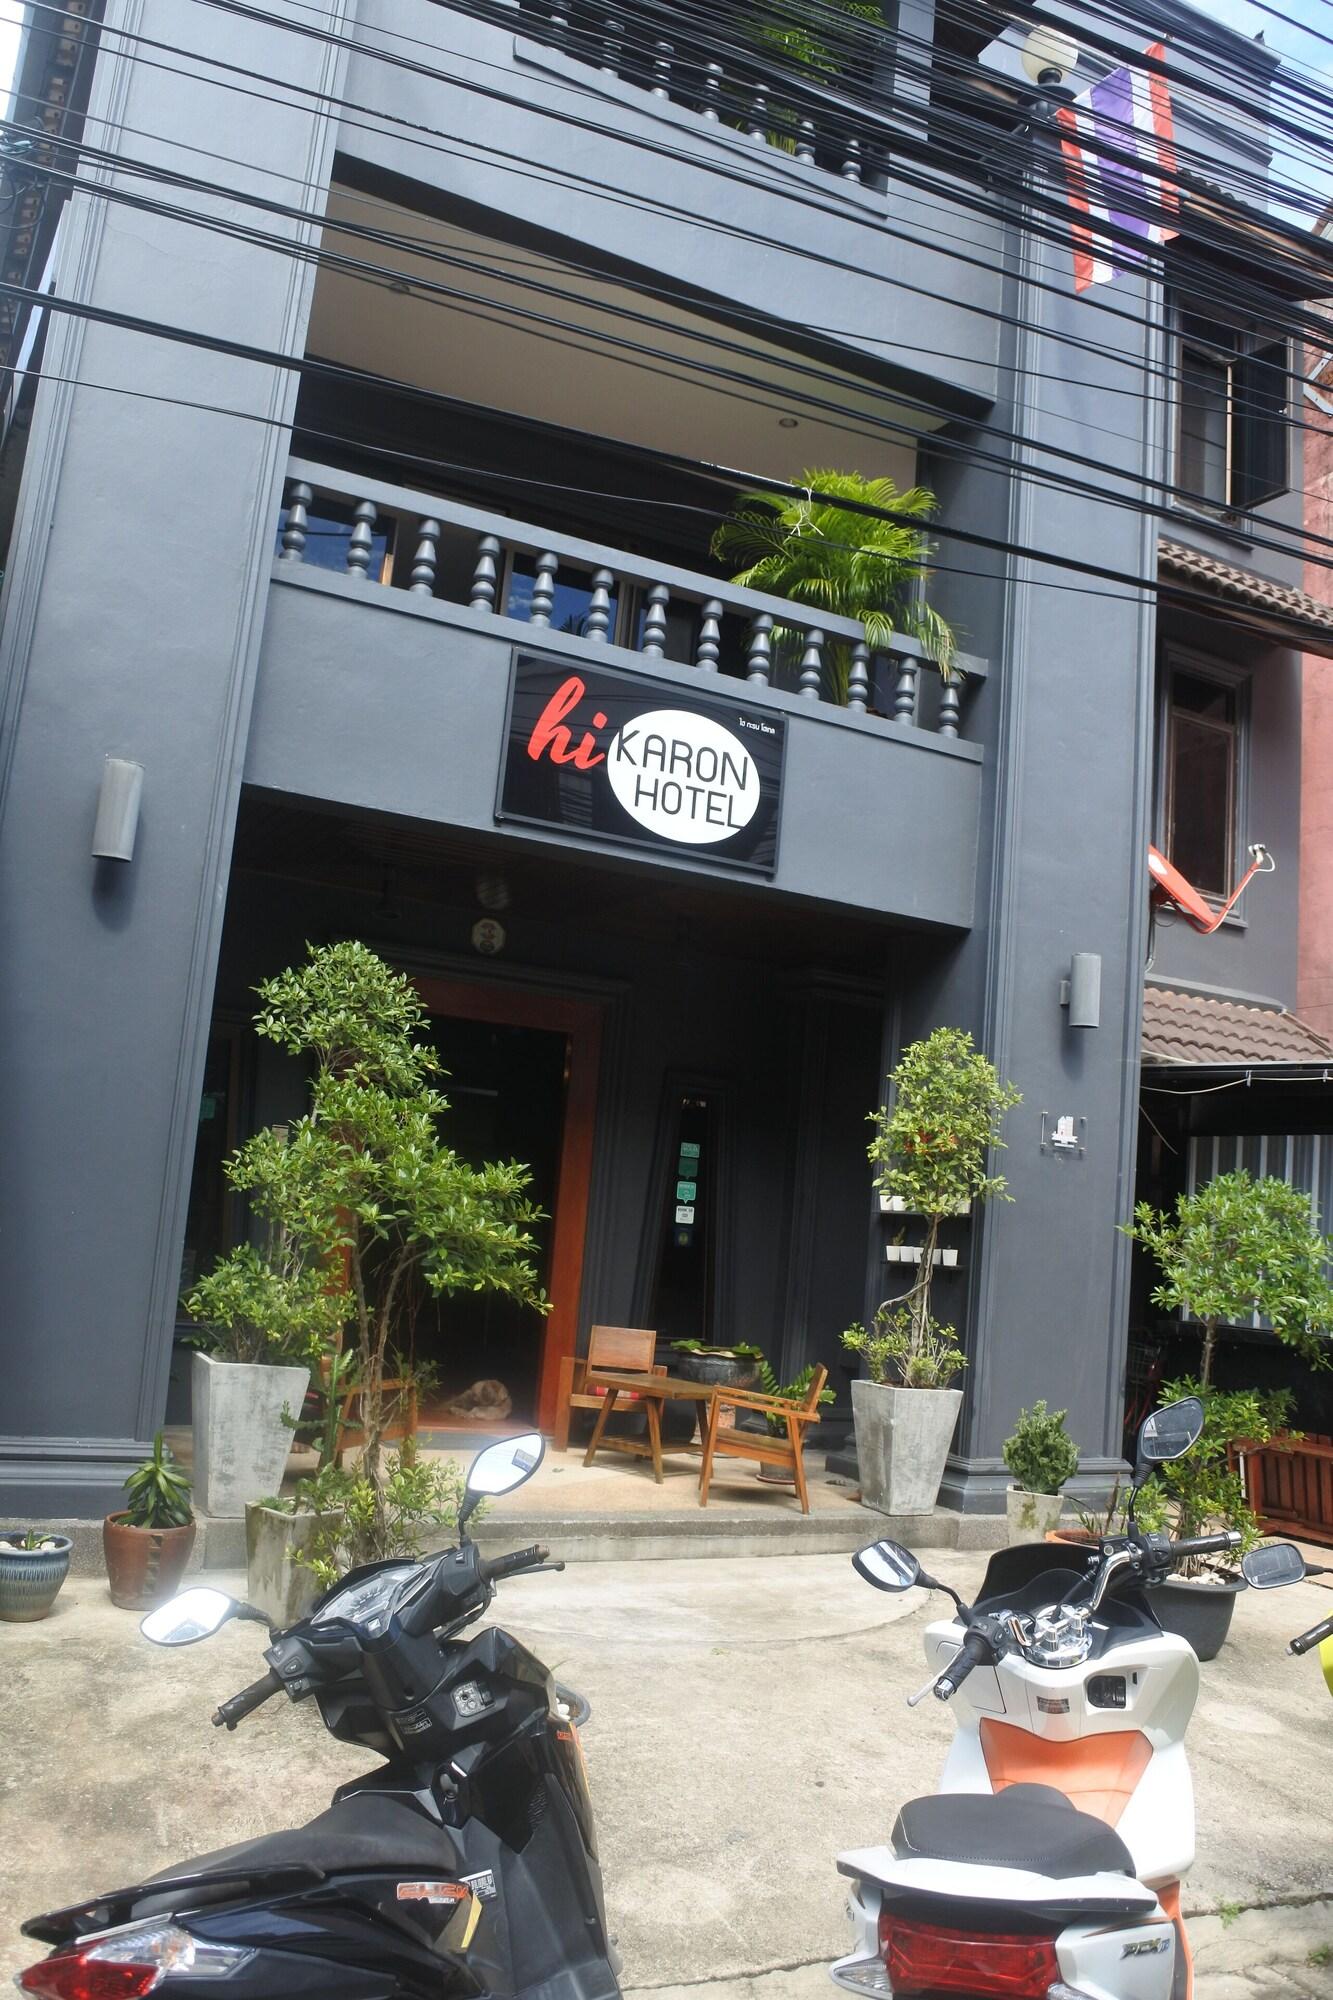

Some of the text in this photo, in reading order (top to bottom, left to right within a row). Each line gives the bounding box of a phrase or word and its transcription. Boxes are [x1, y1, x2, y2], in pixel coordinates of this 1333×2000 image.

[527, 676, 748, 791] hi KARON
[634, 774, 746, 830] HOTEL
